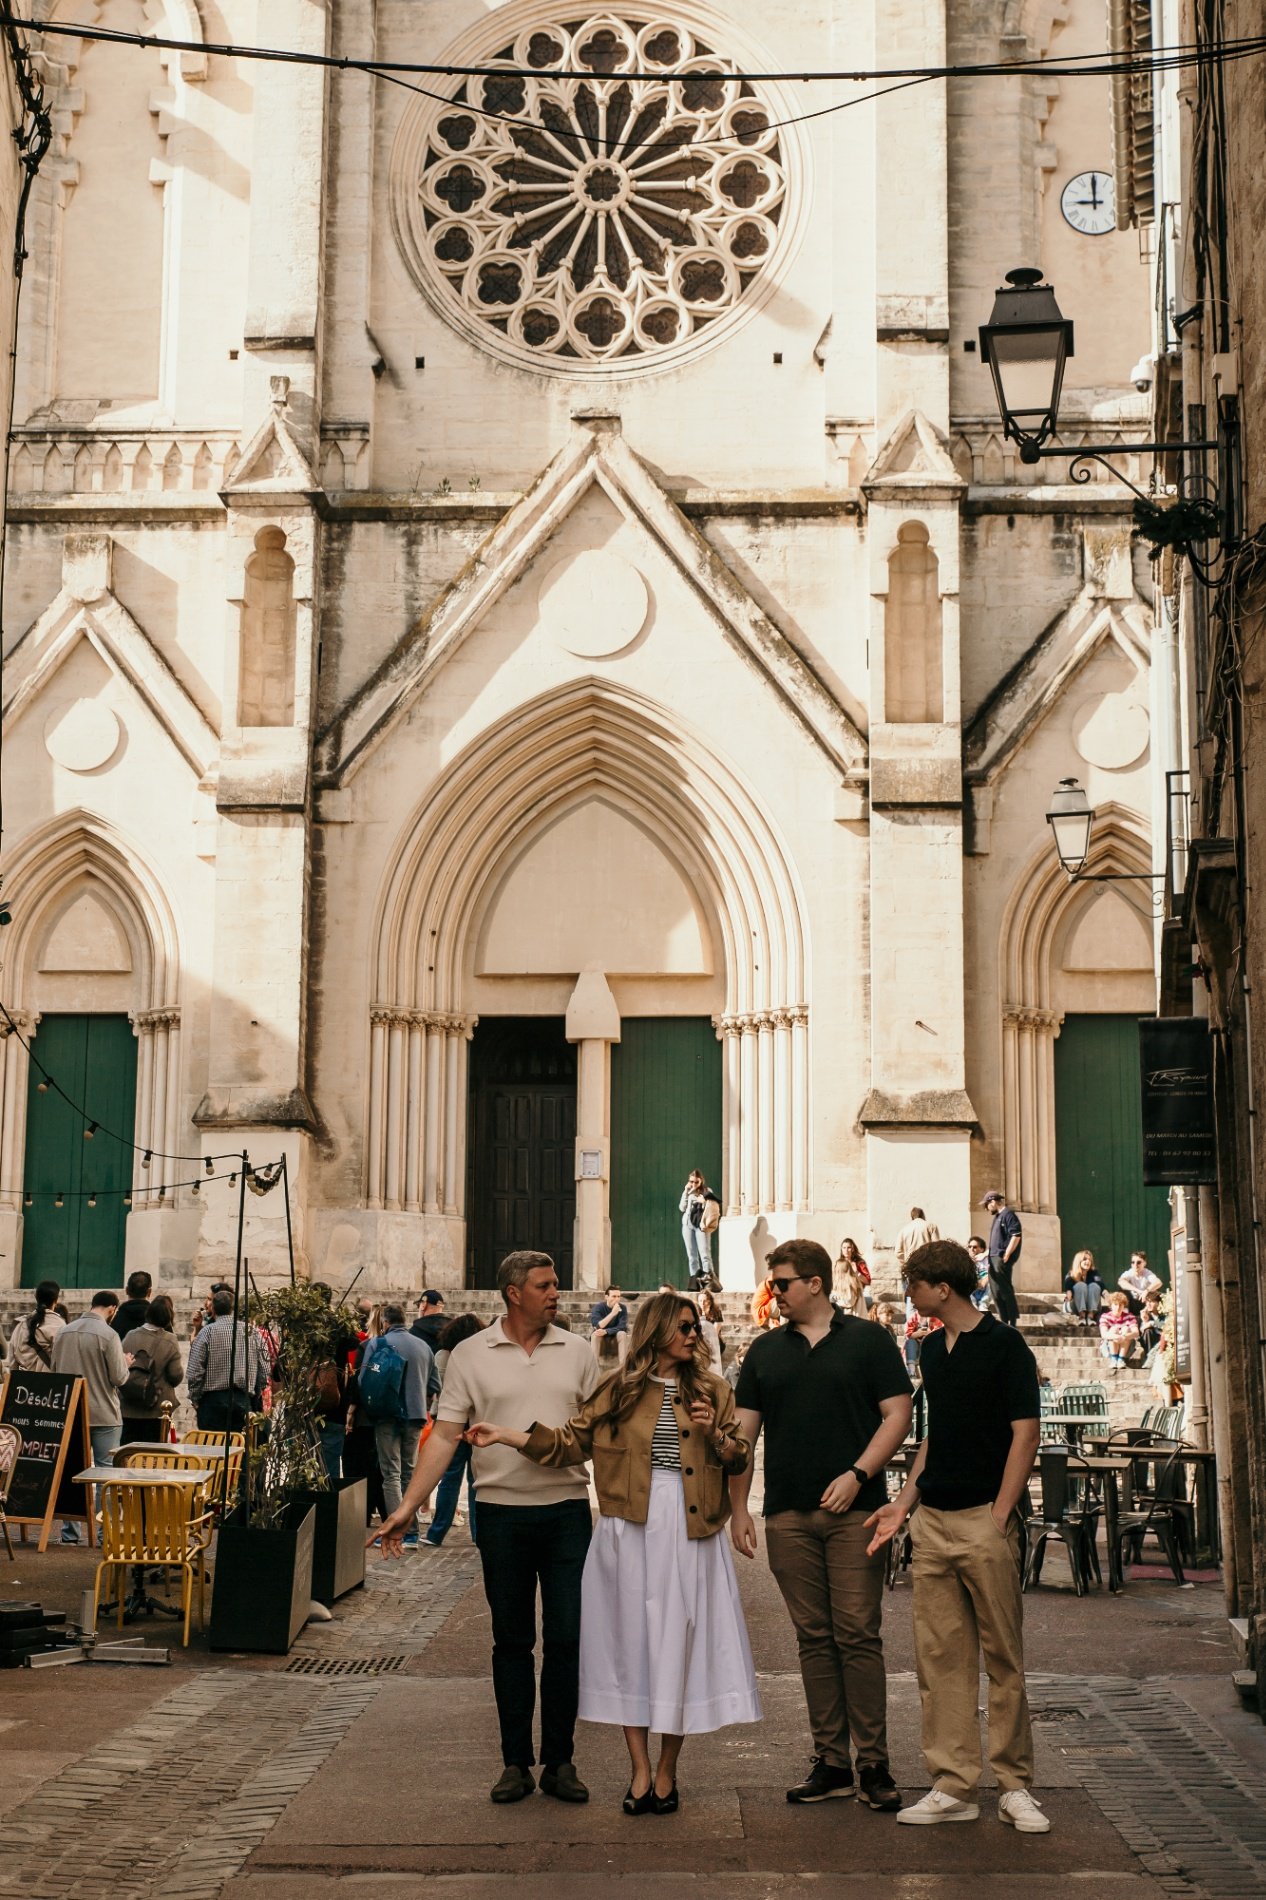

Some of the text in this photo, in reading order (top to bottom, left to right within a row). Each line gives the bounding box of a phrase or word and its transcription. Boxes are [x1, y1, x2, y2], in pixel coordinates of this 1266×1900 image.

[12, 1417, 65, 1429] nous sommes
[20, 1440, 62, 1460] MPLET
